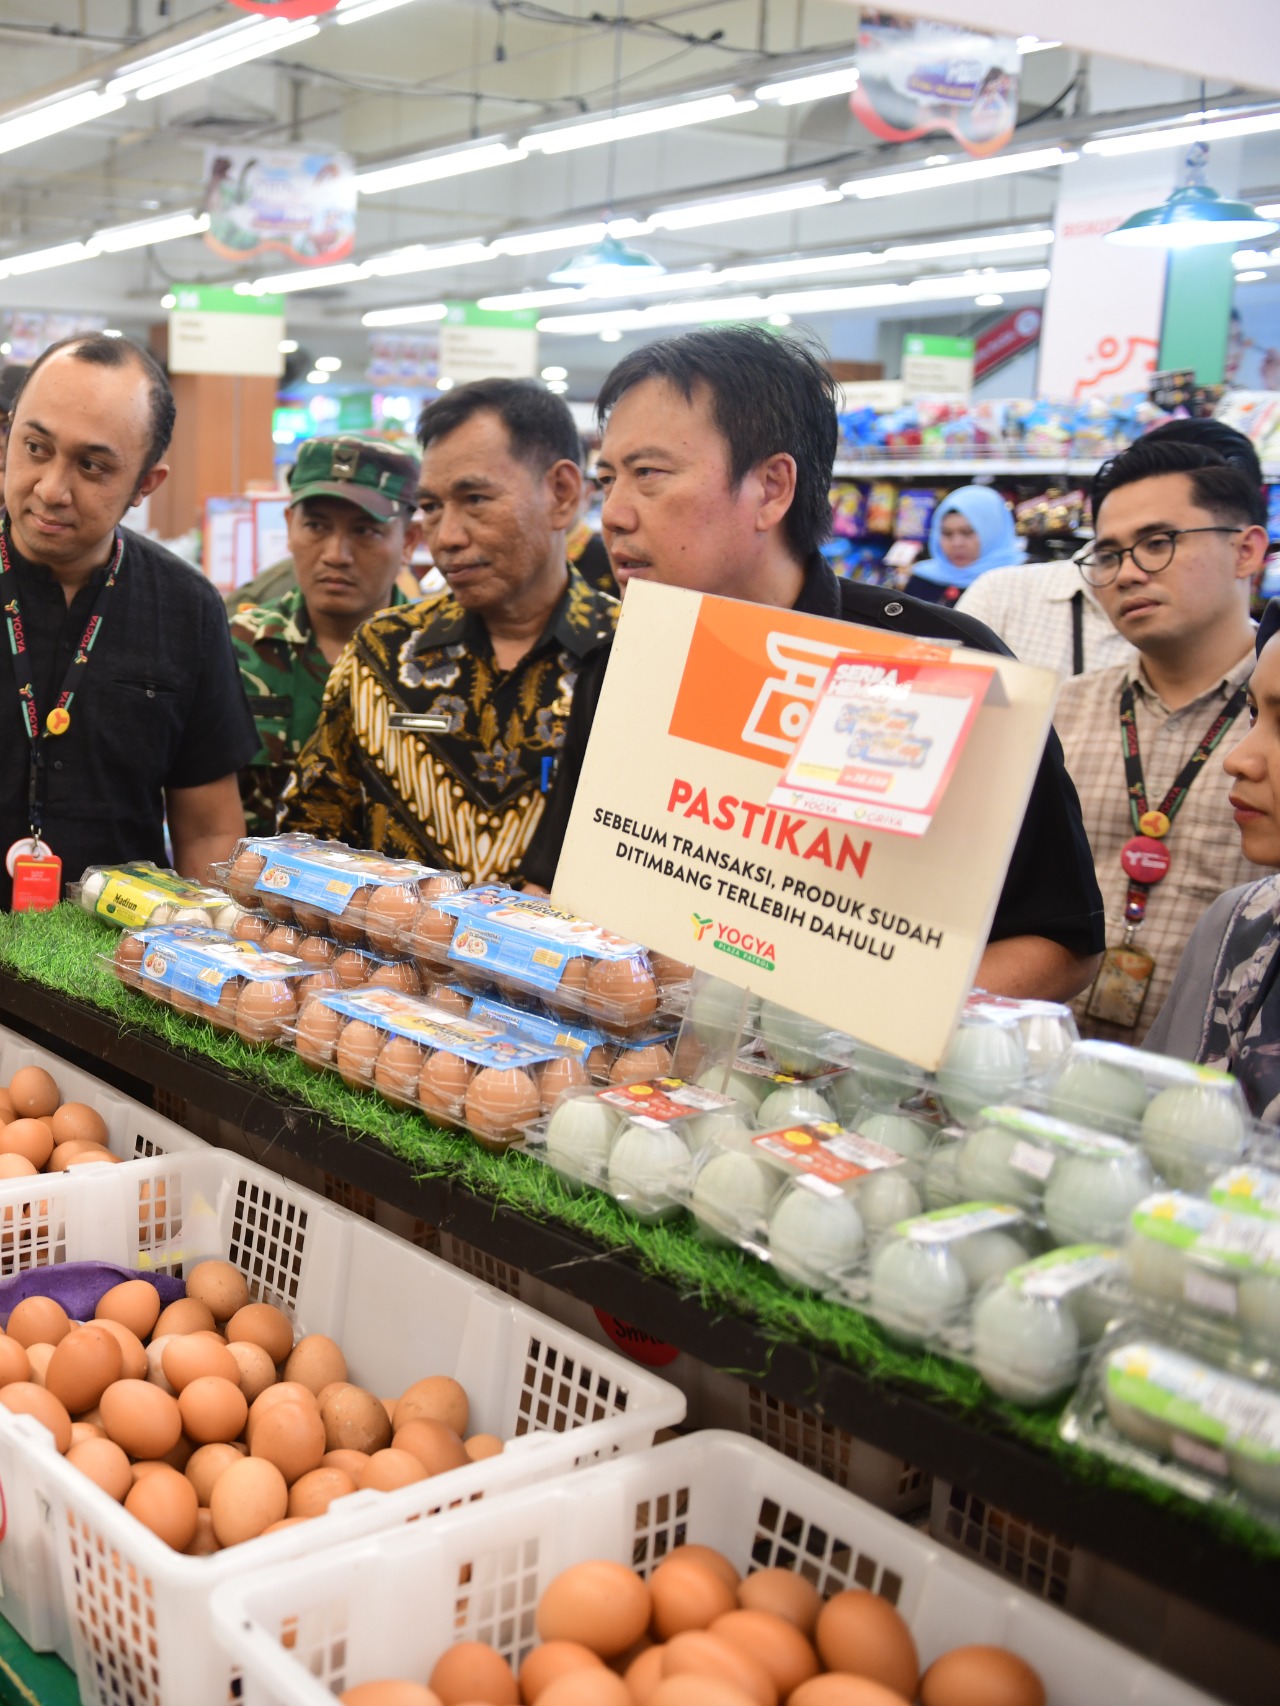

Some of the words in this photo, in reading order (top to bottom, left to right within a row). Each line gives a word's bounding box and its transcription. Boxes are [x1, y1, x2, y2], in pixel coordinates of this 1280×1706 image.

[0, 535, 12, 572] YOGYA
[13, 615, 27, 654] YOGYA
[80, 614, 100, 648] YOGYA
[28, 699, 39, 737] YOGYA
[803, 801, 838, 815] YOGYA
[667, 778, 873, 879] PASTIKAN
[593, 807, 667, 848] SEBELUM
[672, 835, 776, 890] TRANSAKSI,
[781, 875, 866, 921] PRODUK
[867, 907, 944, 950] SUDAH
[114, 893, 138, 912] Madiun
[513, 901, 576, 921] OMEGA-3
[615, 841, 713, 892] DITIMBANG
[717, 879, 807, 928] TERLEBIH
[809, 915, 896, 961] DAHULU
[718, 922, 776, 961] YOGYA
[718, 942, 741, 956] PLAZA
[743, 953, 770, 969] PATROL
